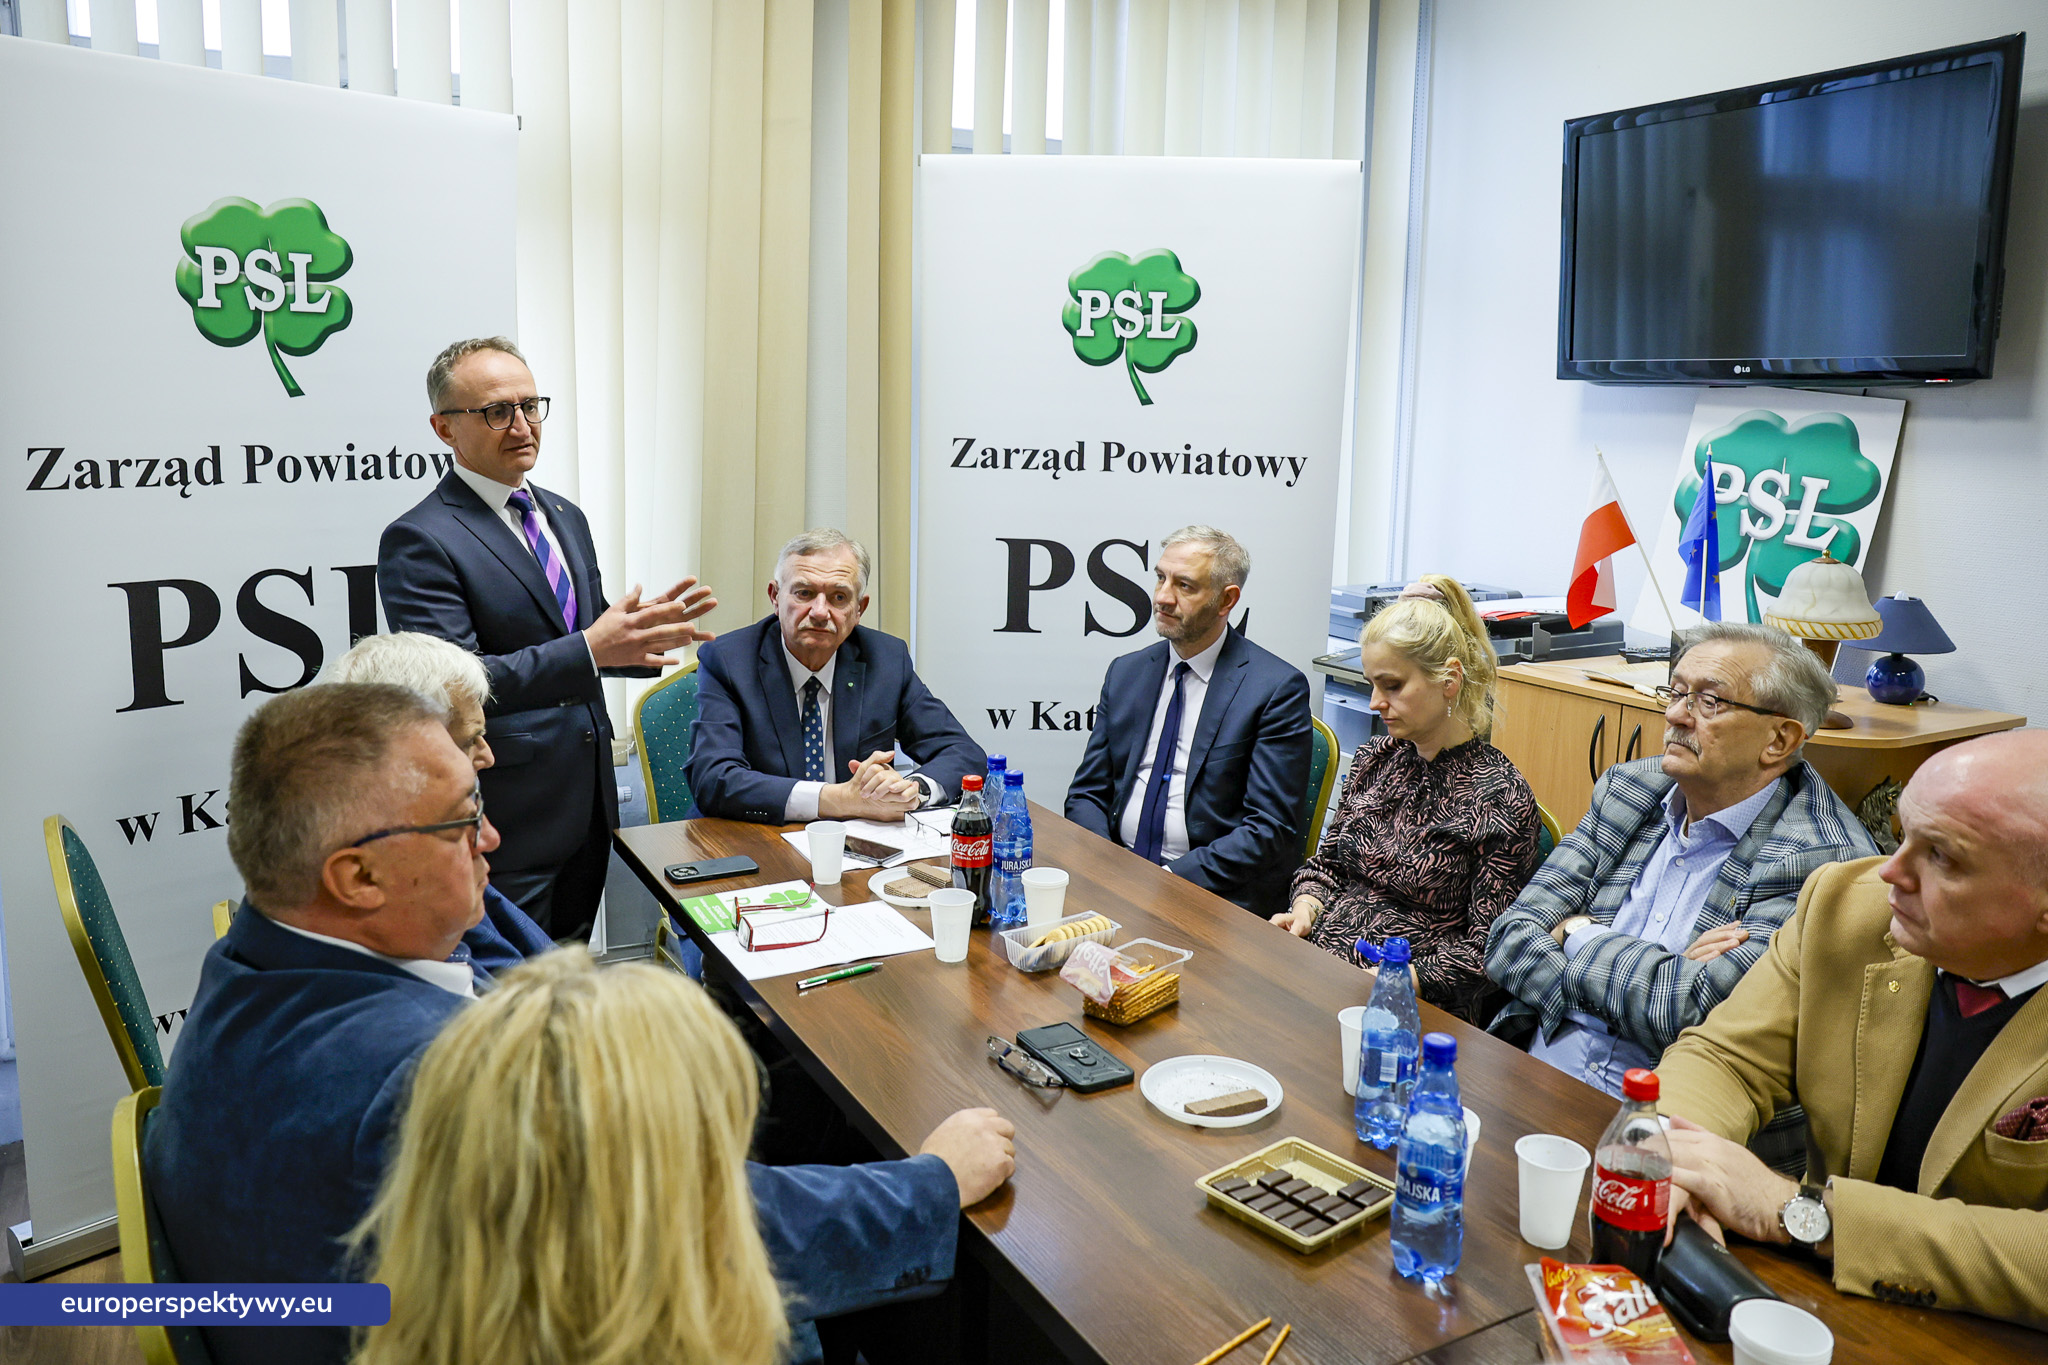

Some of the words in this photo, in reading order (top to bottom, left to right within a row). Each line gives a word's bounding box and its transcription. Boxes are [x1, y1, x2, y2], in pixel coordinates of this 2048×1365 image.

[194, 245, 332, 314] PSL
[1076, 289, 1182, 340] PSL
[25, 445, 225, 498] Zarząd
[950, 437, 1086, 480] Zarząd
[1100, 441, 1308, 487] Powiatowy
[993, 537, 1250, 637] PS
[986, 708, 1017, 730] w
[116, 811, 160, 845] w
[176, 789, 230, 835] K
[951, 838, 991, 857] Coca-Cola
